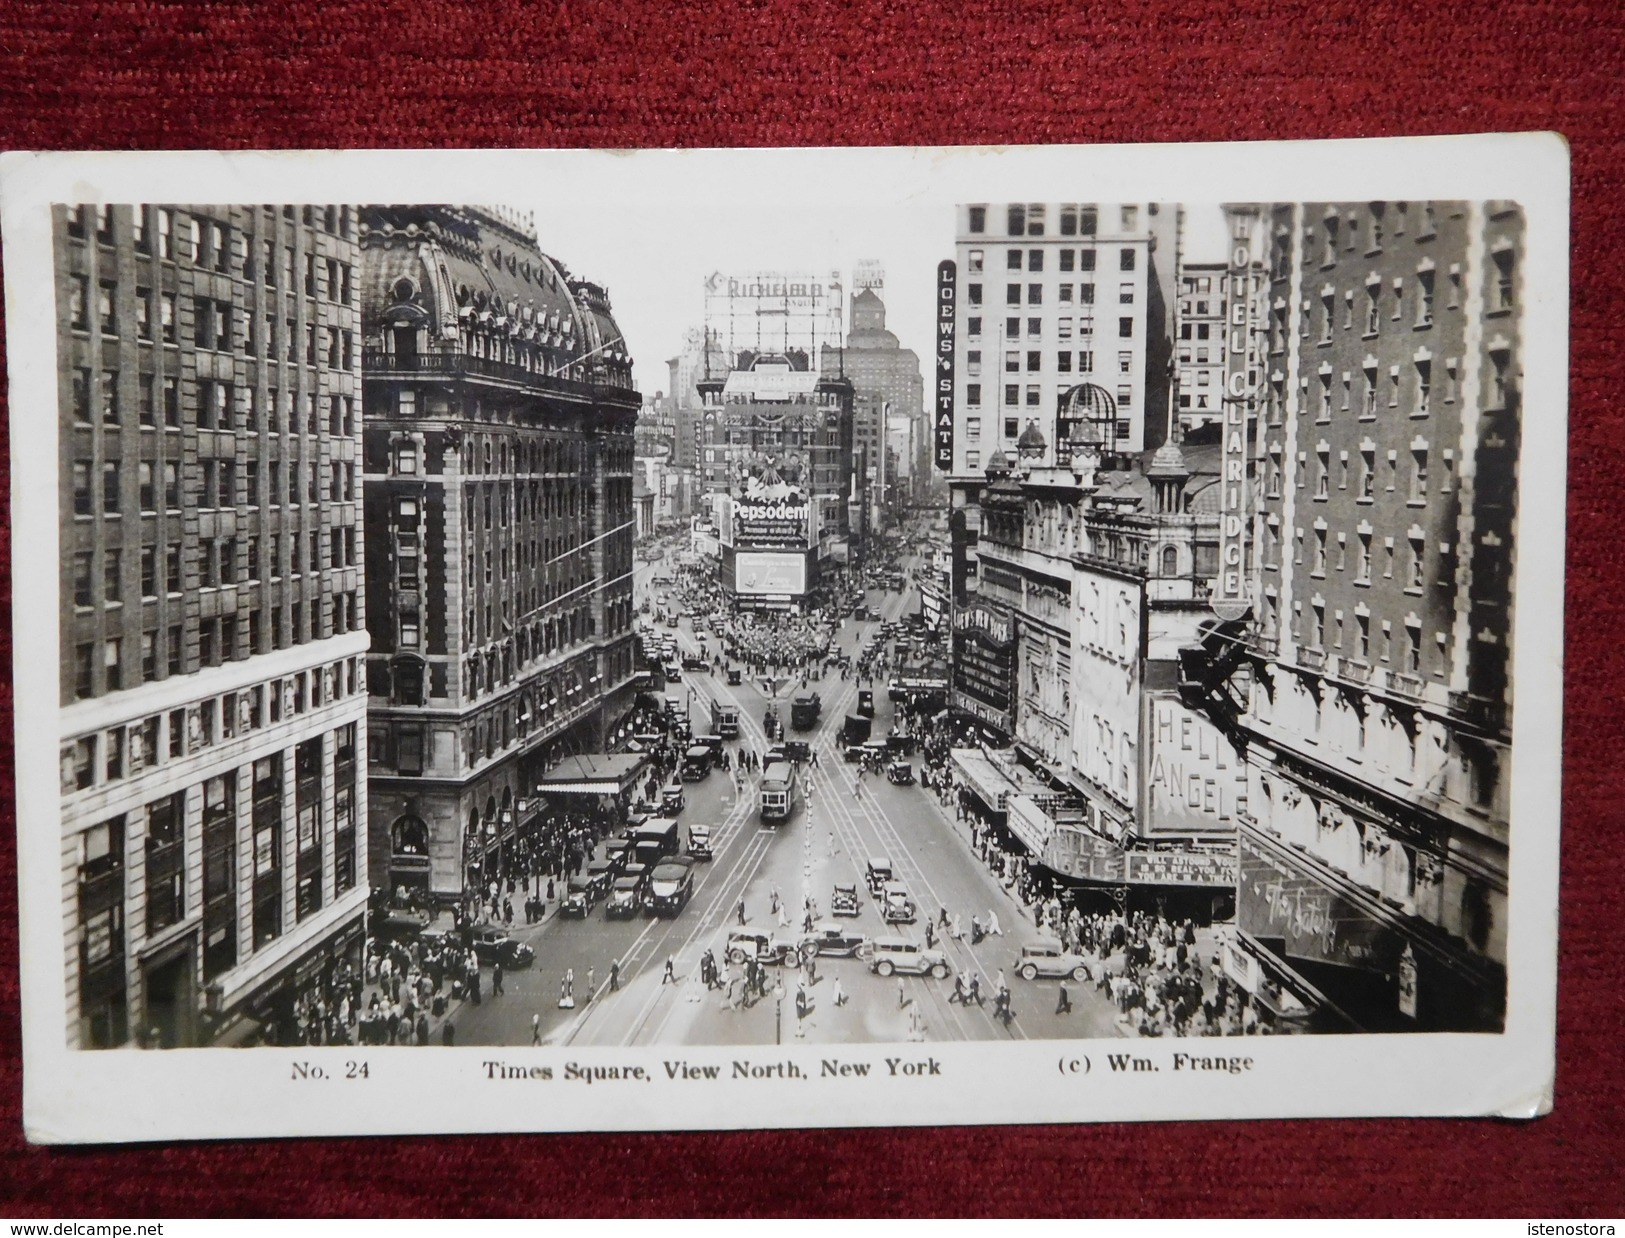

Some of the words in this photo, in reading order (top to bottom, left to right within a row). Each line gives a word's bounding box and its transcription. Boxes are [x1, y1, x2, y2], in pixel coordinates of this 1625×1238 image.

[1230, 217, 1248, 354] HOTEL
[939, 379, 952, 461] STATE
[1224, 371, 1245, 594] CLARIDGE
[732, 501, 809, 521] Pepsodent
[1161, 873, 1178, 881] ARE
[291, 1061, 330, 1080] No.
[345, 1060, 370, 1079] 24
[483, 1060, 553, 1080] Times
[564, 1061, 651, 1084] Square,
[664, 1060, 721, 1080] View
[731, 1059, 808, 1080] North,
[821, 1059, 871, 1077] New
[884, 1057, 941, 1076] York
[1058, 1054, 1092, 1075] (c)
[1107, 1054, 1159, 1073] Wm.
[1173, 1053, 1254, 1074] Frange
